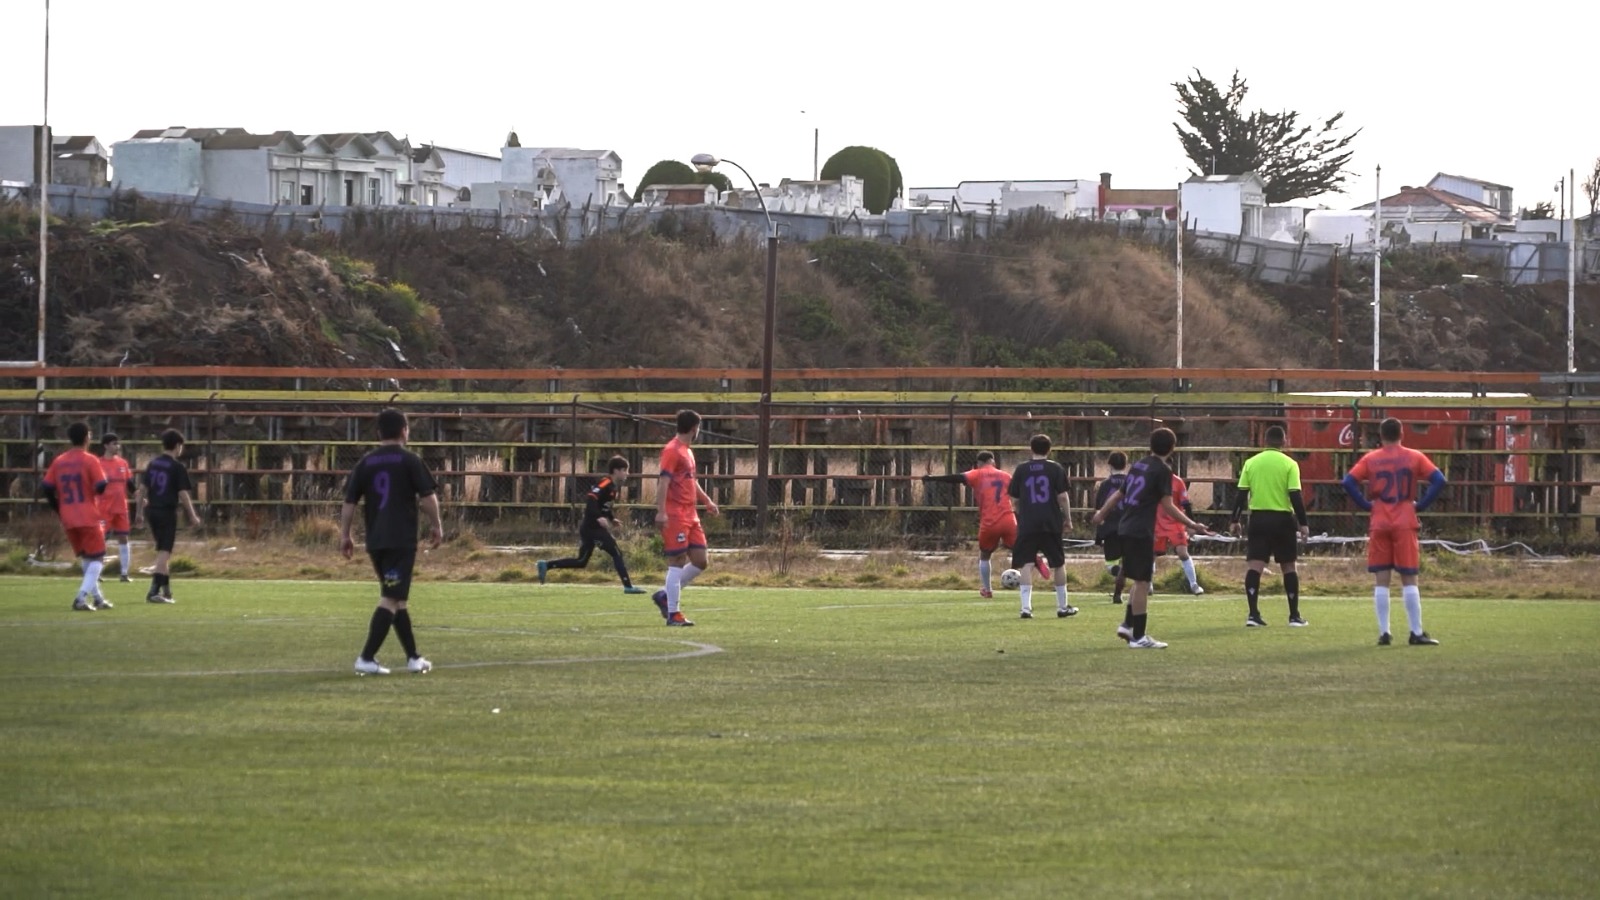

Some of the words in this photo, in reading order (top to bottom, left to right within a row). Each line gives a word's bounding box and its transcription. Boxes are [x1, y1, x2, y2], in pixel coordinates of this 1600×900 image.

[373, 470, 391, 510] 9
[991, 480, 1003, 504] 7
[1025, 474, 1051, 504] 13
[1375, 467, 1412, 505] 20
